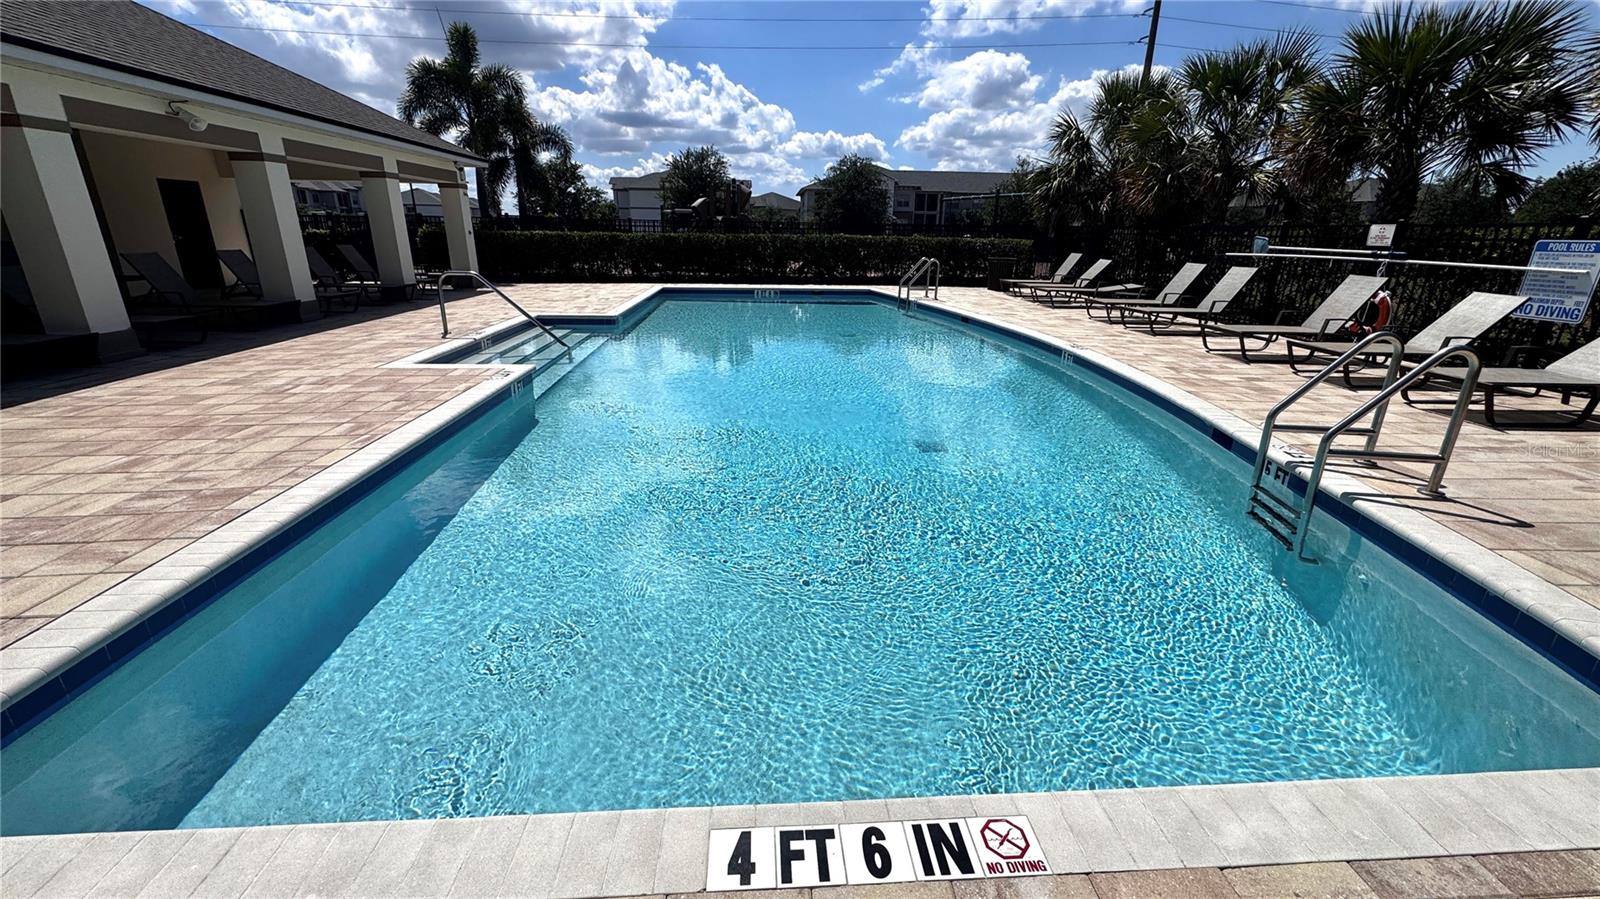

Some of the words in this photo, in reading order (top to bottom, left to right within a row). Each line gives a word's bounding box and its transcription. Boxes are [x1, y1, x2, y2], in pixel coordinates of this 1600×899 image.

[1547, 243, 1567, 251] POOL
[1569, 243, 1597, 252] RULES
[1535, 305, 1581, 320] DIVING
[1274, 466, 1290, 485] FT
[727, 831, 756, 886] 4
[779, 828, 835, 884] FT
[862, 826, 892, 879] 6
[912, 822, 976, 876] IN
[986, 862, 1004, 875] NO
[1008, 860, 1047, 874] DIVING
